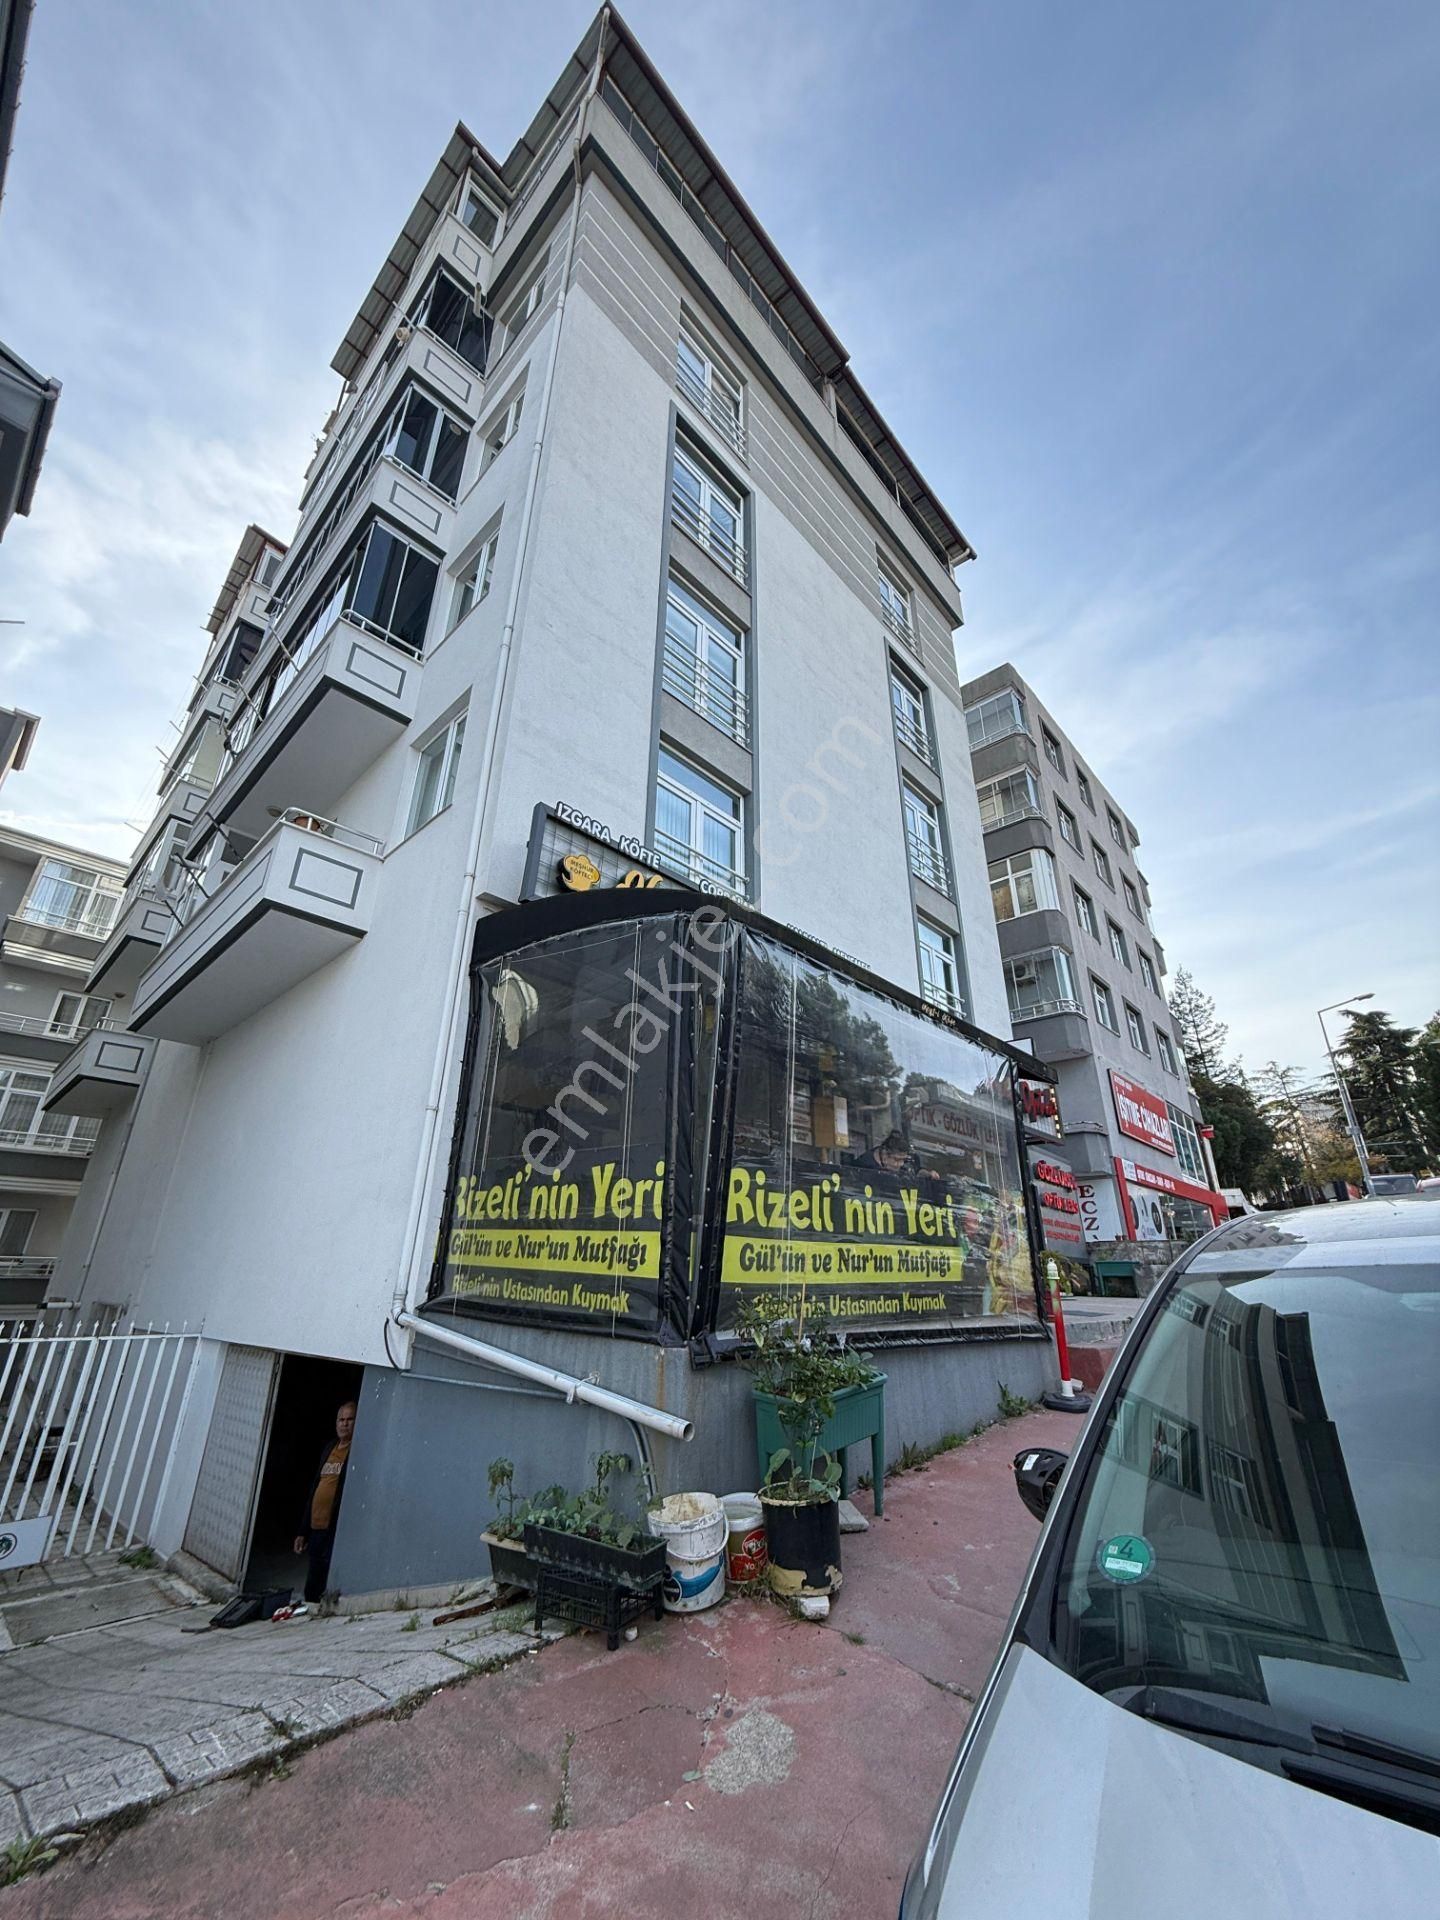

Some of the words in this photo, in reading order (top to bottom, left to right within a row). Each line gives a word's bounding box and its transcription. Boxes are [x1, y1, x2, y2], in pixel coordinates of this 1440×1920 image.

[556, 801, 612, 843] IZGARA
[619, 836, 661, 869] KÖFTE
[591, 1160, 665, 1220] Yeri
[726, 1167, 895, 1234] Rizeli'nin
[900, 1188, 957, 1239] Yeri
[1077, 1184, 1100, 1240] ECZ
[450, 1233, 492, 1256] Gül'ün
[495, 1242, 512, 1260] ve
[514, 1234, 569, 1261] Nur'un
[573, 1234, 648, 1272] Mutfağı
[739, 1242, 806, 1273] Gül'ün
[811, 1254, 832, 1273] ve
[837, 1247, 893, 1273] Nur'un
[897, 1249, 951, 1278] Mutfağı
[502, 1277, 569, 1306] Ustasından
[572, 1283, 630, 1313] Kuymak
[829, 1294, 900, 1316] Ustasından
[903, 1291, 947, 1315] Kuymak
[1119, 1538, 1135, 1558] 4
